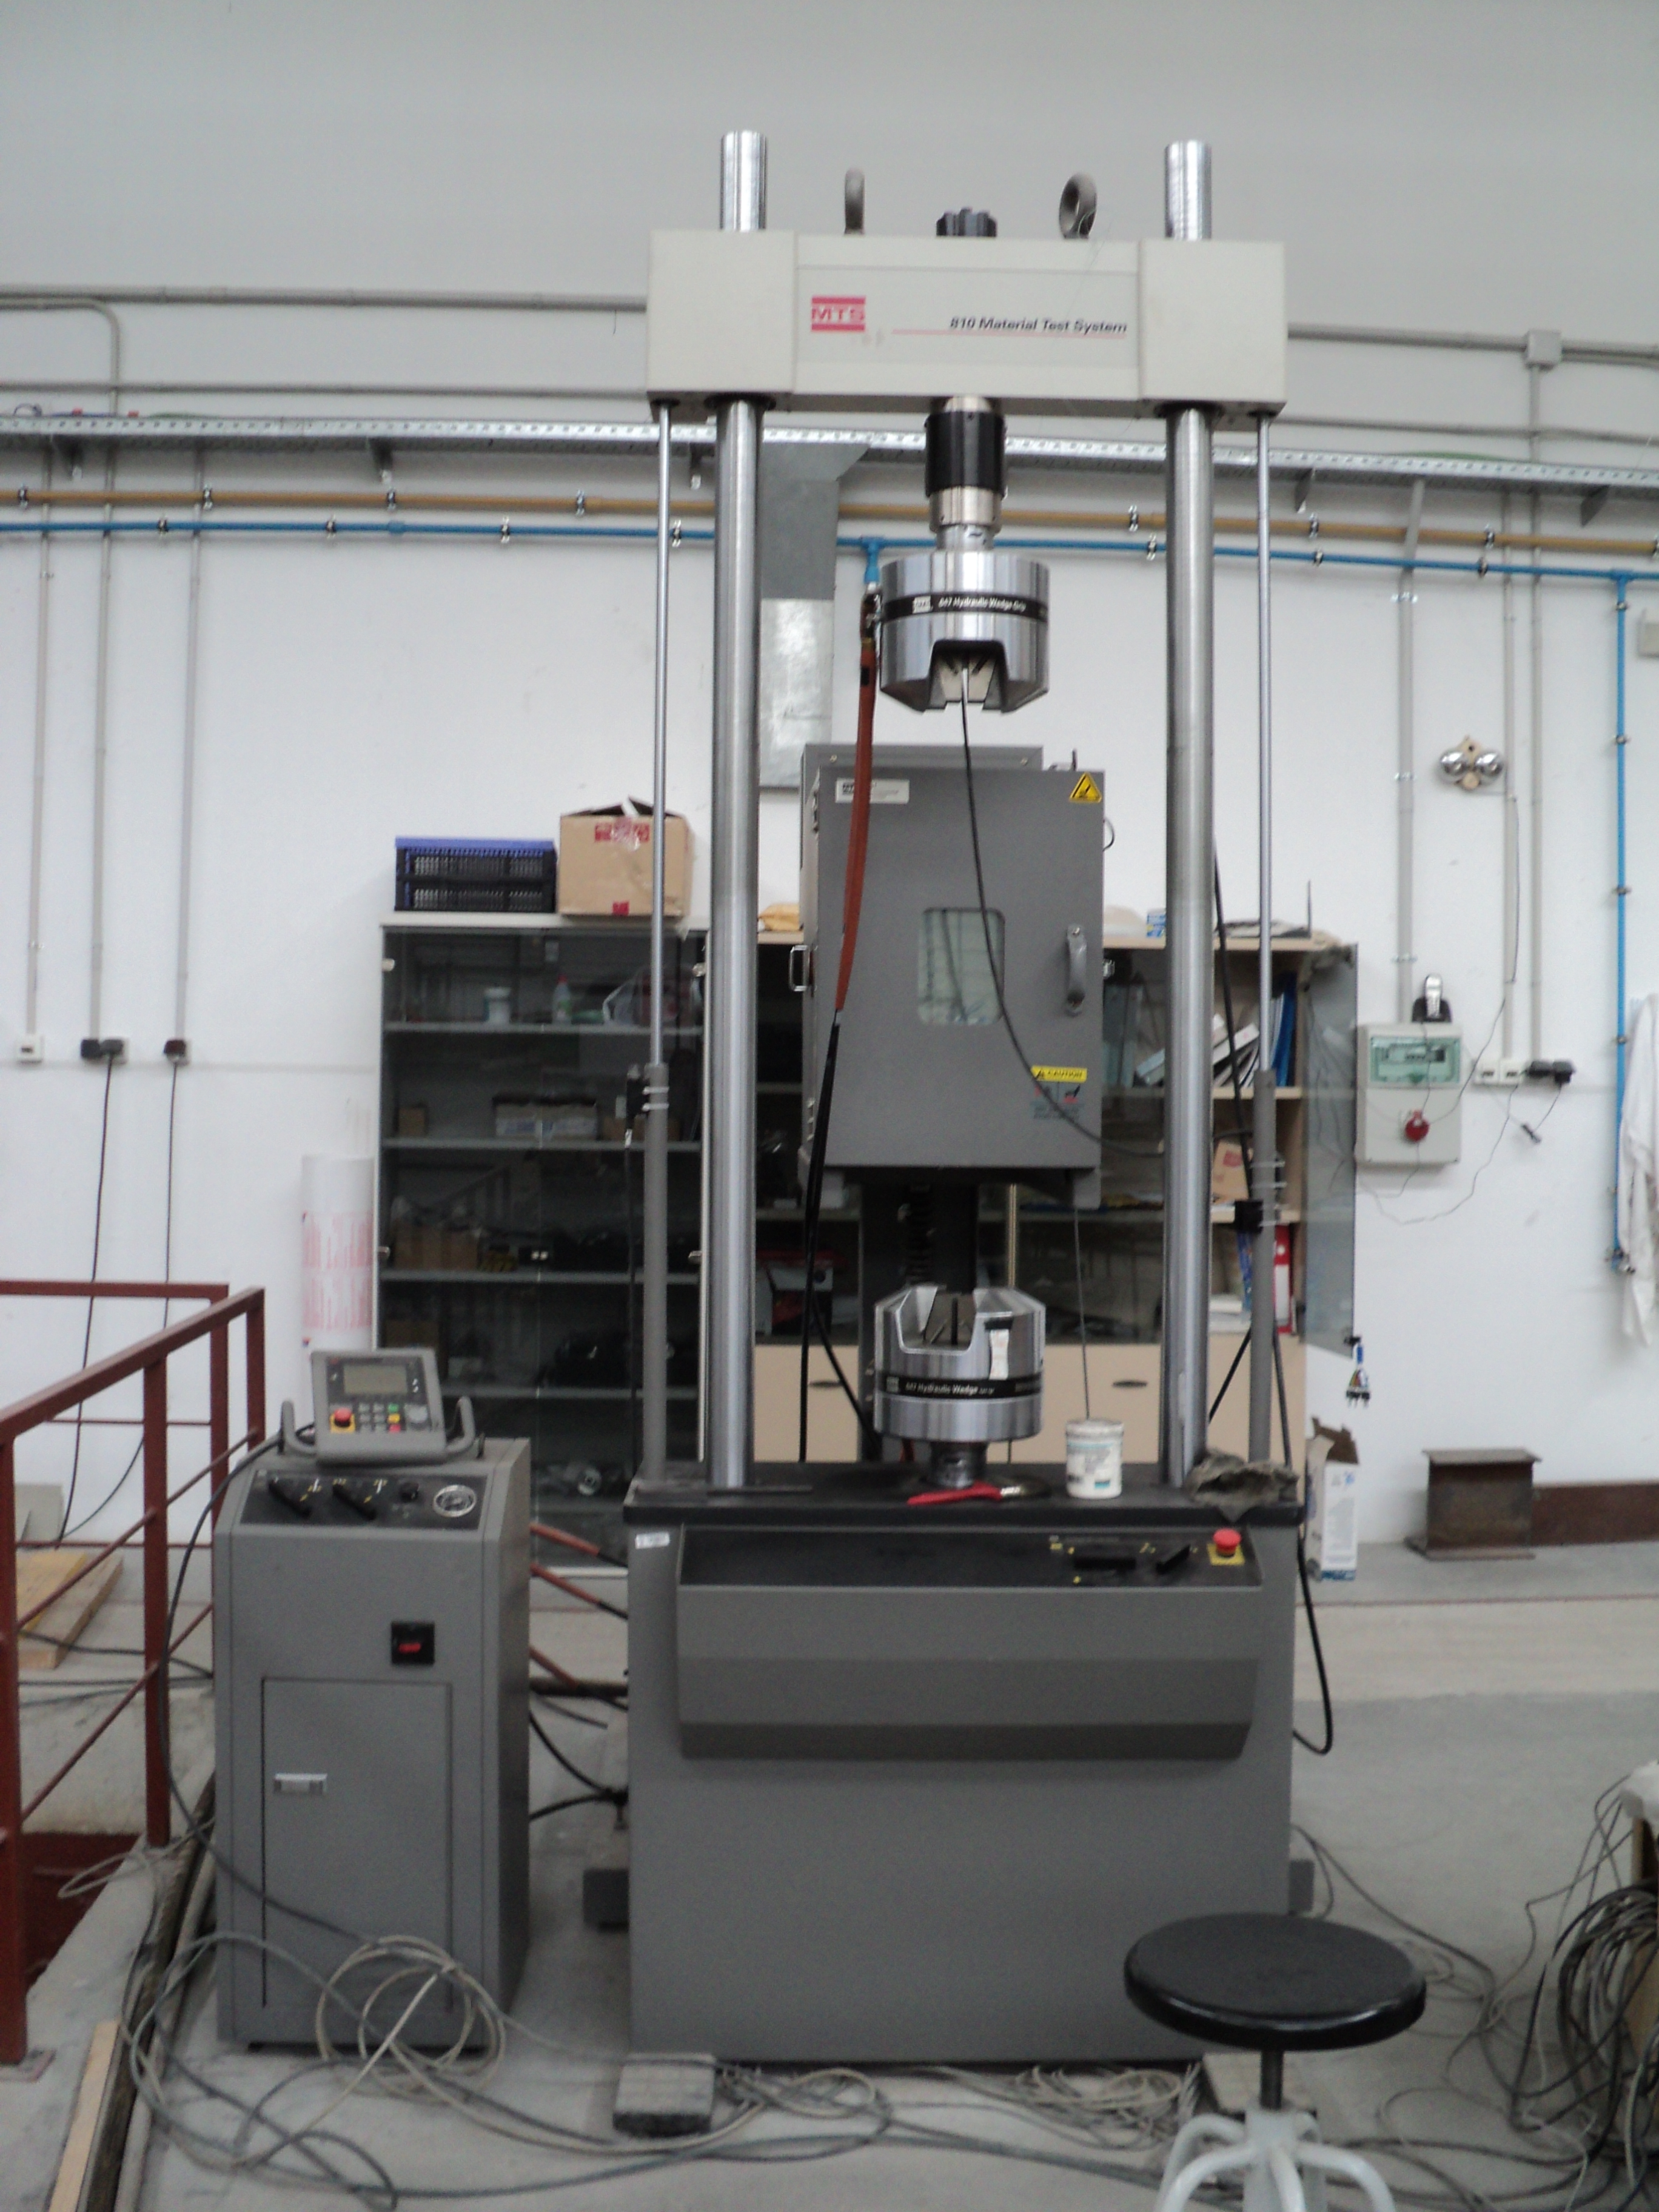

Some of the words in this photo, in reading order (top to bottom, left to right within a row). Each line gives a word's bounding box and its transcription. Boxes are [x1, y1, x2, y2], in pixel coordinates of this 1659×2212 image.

[950, 317, 975, 329] 810
[979, 316, 1038, 330] Material
[1043, 318, 1069, 331] Test
[1074, 320, 1127, 336] System
[953, 596, 988, 609] Hydraulic
[988, 597, 1013, 611] Wedge
[917, 1382, 951, 1395] Hydraulic
[951, 1384, 979, 1396] Wedge
